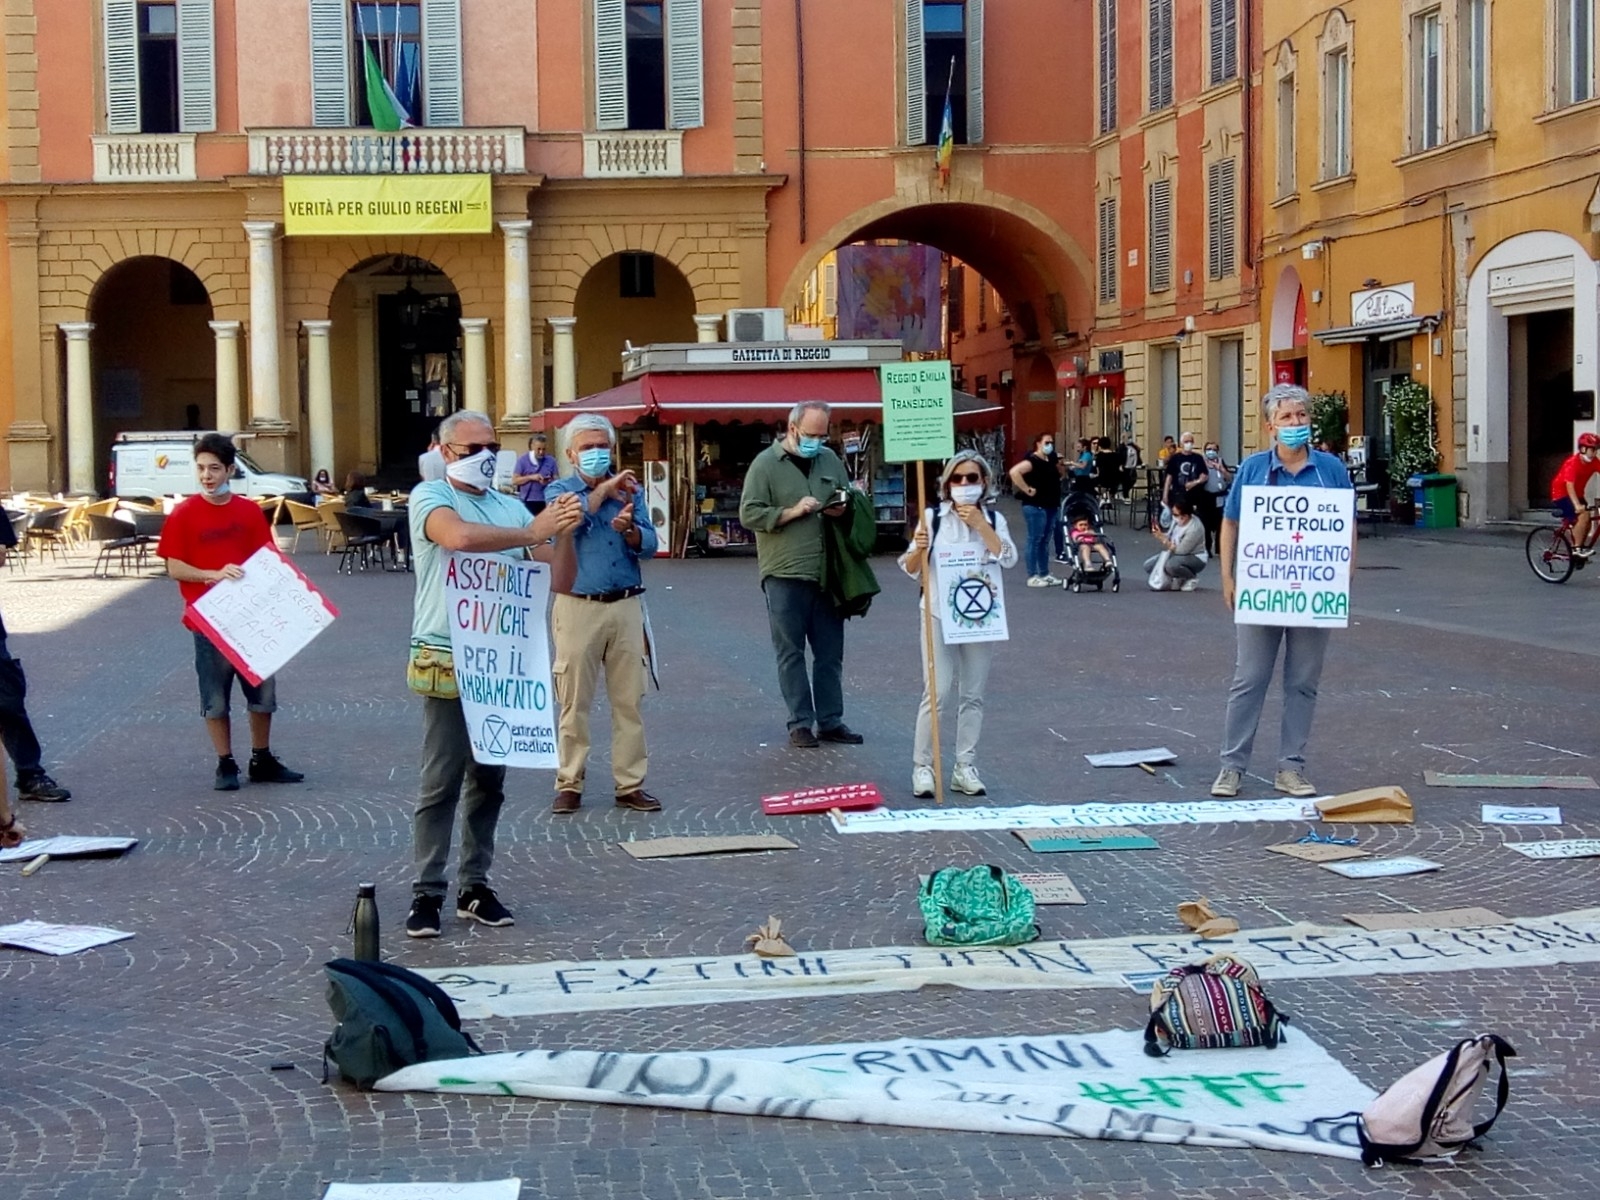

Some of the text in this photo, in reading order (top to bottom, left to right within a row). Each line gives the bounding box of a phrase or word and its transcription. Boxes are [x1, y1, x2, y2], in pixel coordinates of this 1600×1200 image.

[289, 199, 463, 216] VERITÀ PER GIULIO REGENI
[732, 348, 830, 361] GAZZETTA DI REGGIO
[886, 371, 947, 384] REGGIO EMILIA
[912, 386, 921, 394] IN
[891, 398, 944, 410] TRANSIZIONE
[1254, 496, 1340, 514] PICCO DEL
[1262, 516, 1344, 532] PETROLIO
[1244, 543, 1350, 563] CAMBIAMENTO
[1247, 563, 1336, 582] CLIMATICO
[1238, 588, 1348, 617] AGIAMO ORA
[464, 645, 498, 674] PER
[457, 669, 547, 711] AMBIAMENTO
[511, 725, 553, 738] extinction
[514, 740, 555, 754] rebellion
[1078, 1071, 1306, 1110] #FFF
